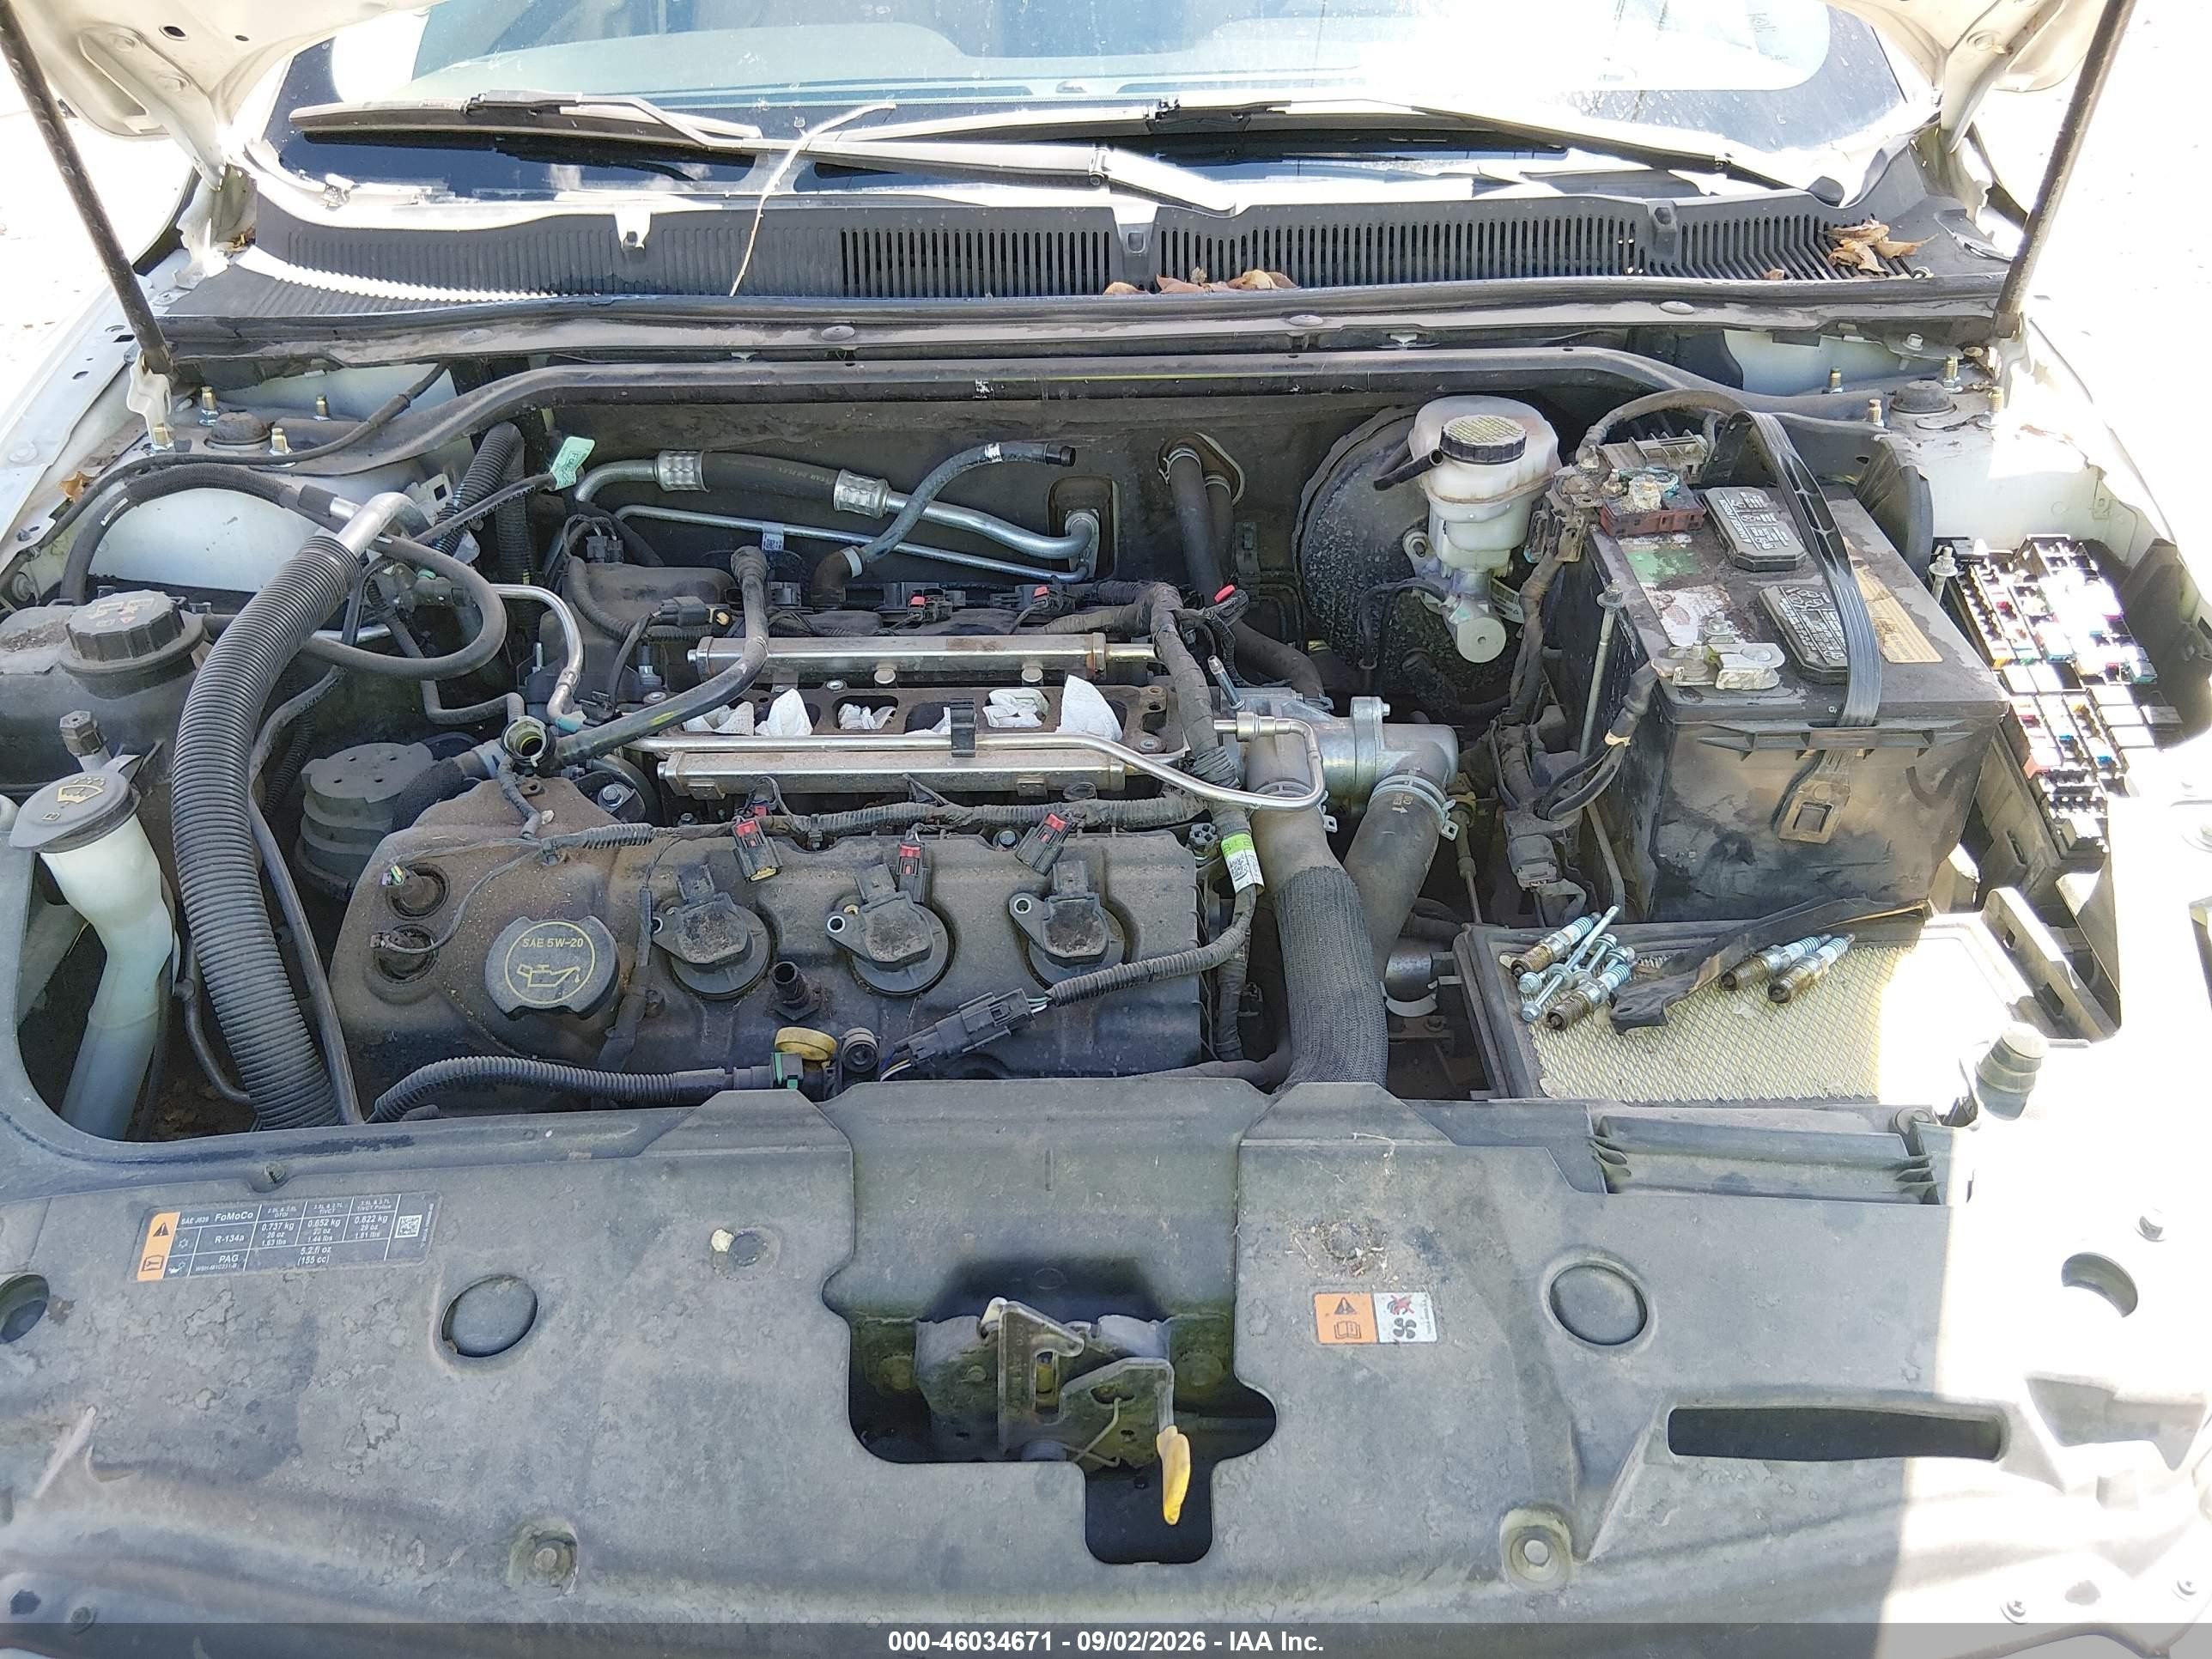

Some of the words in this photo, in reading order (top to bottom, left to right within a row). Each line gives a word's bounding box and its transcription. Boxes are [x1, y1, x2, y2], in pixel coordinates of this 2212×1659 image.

[522, 938, 544, 948] SAE
[545, 938, 584, 948] 5W-20
[215, 1211, 253, 1222] FoMoCo
[354, 1215, 376, 1224] 0.822
[377, 1214, 388, 1224] kg
[261, 1223, 283, 1231] 0.737
[284, 1222, 295, 1231] kg
[307, 1218, 330, 1228] 0.652
[331, 1218, 341, 1227] kg
[214, 1234, 245, 1243] R-134a
[300, 1246, 313, 1255] 5.2
[218, 1254, 239, 1263] PAG
[296, 1255, 315, 1267] (155
[316, 1254, 330, 1264] cc)
